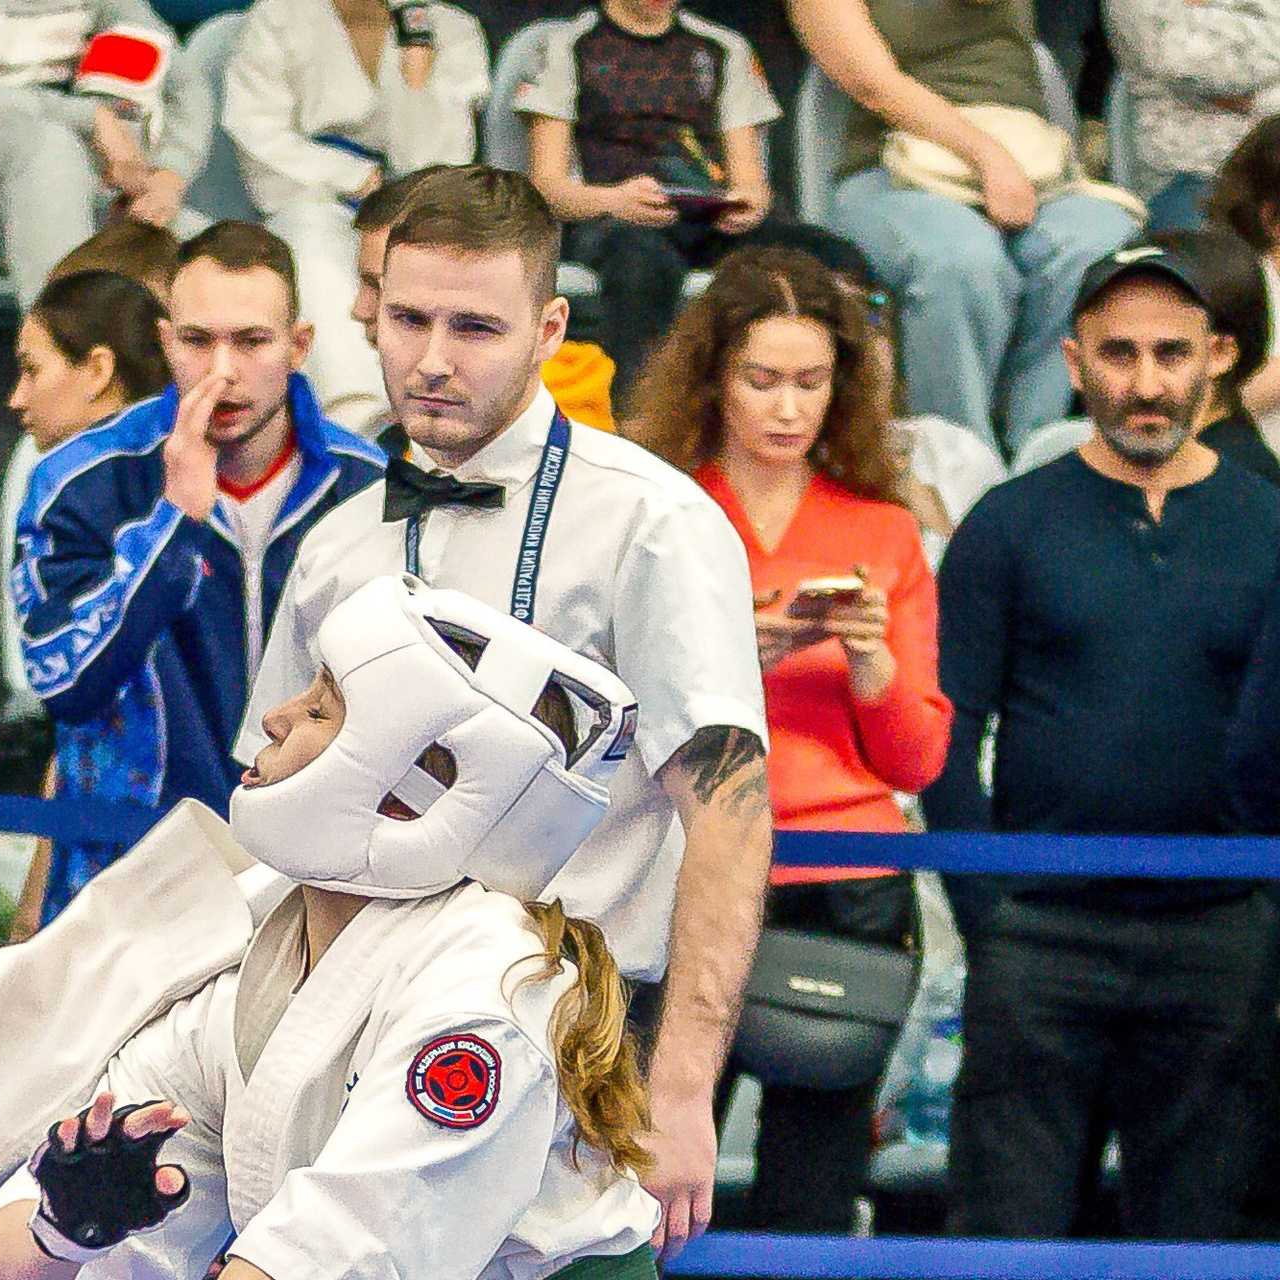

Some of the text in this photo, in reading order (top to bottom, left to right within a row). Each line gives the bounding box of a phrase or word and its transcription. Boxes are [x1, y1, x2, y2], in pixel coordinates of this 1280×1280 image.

[513, 445, 564, 619] ФЕДЕРАЦИЯ КИОКУШИН РОССИИ
